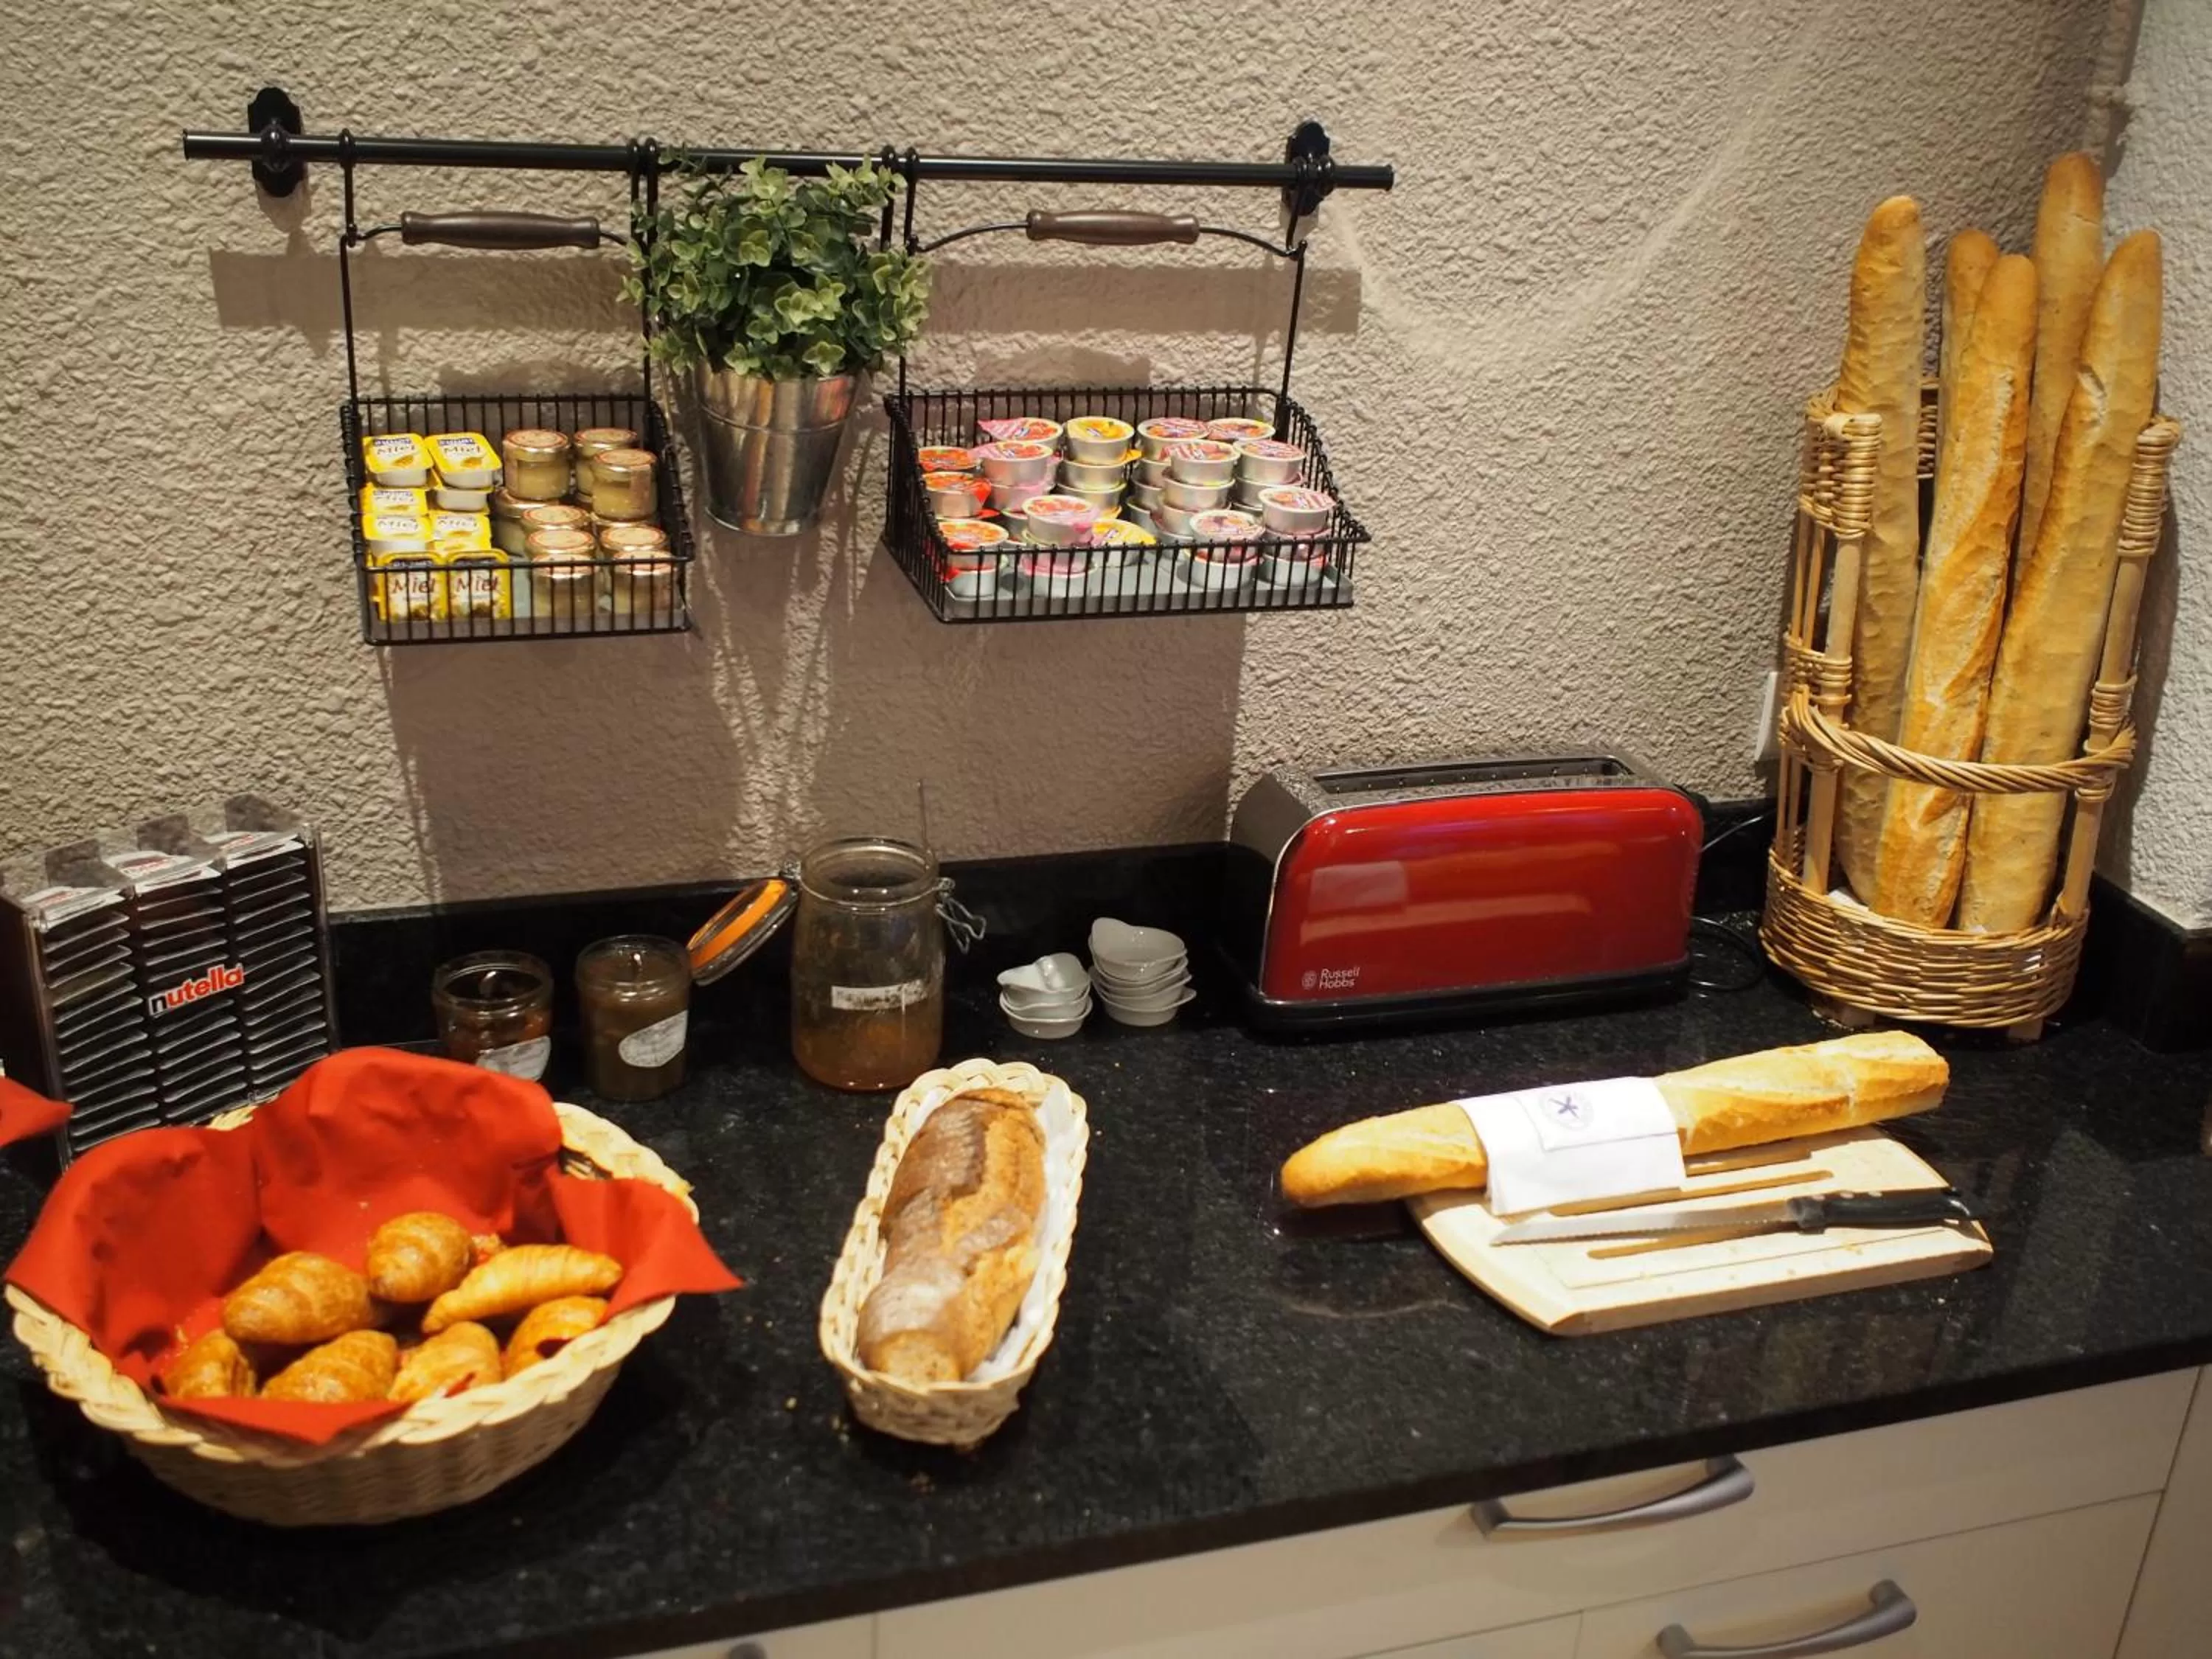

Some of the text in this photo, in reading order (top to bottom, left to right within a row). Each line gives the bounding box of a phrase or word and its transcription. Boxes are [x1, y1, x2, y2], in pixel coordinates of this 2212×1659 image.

[392, 577, 436, 594] Miel
[456, 576, 498, 592] Miel
[1321, 967, 1360, 979] Russell
[150, 964, 243, 1016] nutella
[1319, 977, 1354, 989] Hobbs
